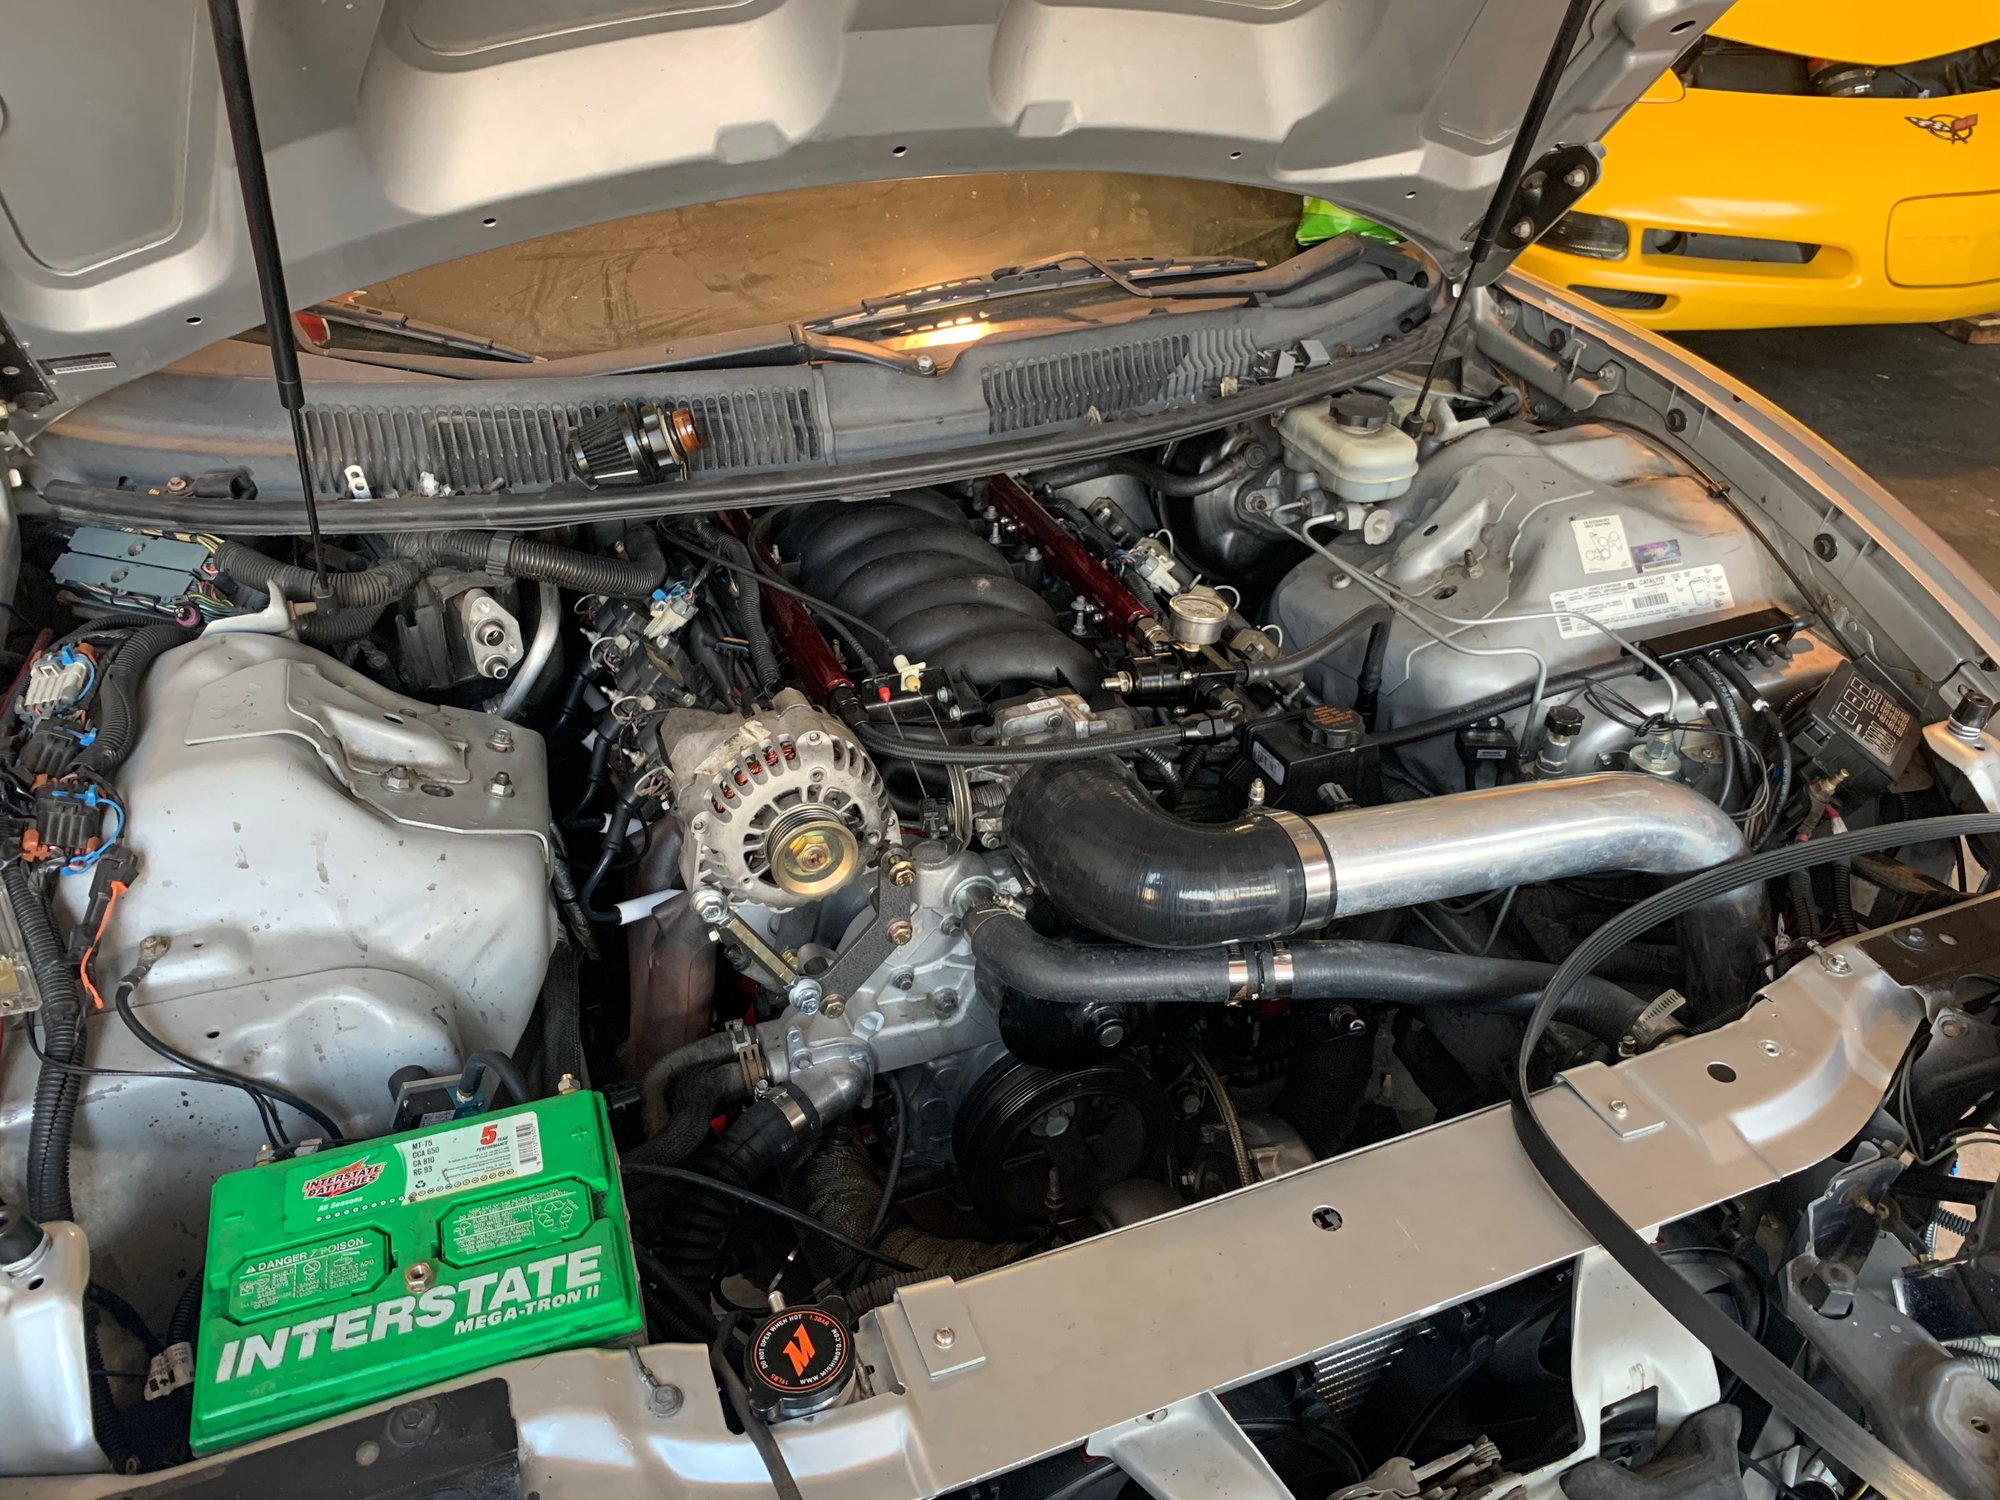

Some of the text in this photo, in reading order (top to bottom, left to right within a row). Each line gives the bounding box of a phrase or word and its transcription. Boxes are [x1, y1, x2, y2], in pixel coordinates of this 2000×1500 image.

[1638, 576, 1666, 586] CATALYST
[480, 1123, 498, 1146] 5
[412, 1140, 433, 1150] MT-75
[476, 1141, 509, 1152] PERFORMANCE
[412, 1150, 426, 1159] CCA
[427, 1146, 440, 1155] 650
[413, 1156, 435, 1168] CA 810
[305, 1164, 383, 1190] INTERSTATE
[413, 1165, 433, 1176] RC 93
[307, 1174, 377, 1197] BATTERIES
[318, 1196, 364, 1212] All Seasons
[258, 1252, 307, 1271] DANGER
[320, 1237, 364, 1255] POISON
[215, 1245, 602, 1384] INTERSTATE
[454, 1285, 600, 1335] MEGA-TRON II
[771, 1318, 788, 1332] WHEN
[789, 1314, 803, 1322] HOT
[760, 1332, 772, 1347] OPEN
[799, 1328, 842, 1385] WWW.MISHIMOTO.COM
[760, 1360, 768, 1369] DO
